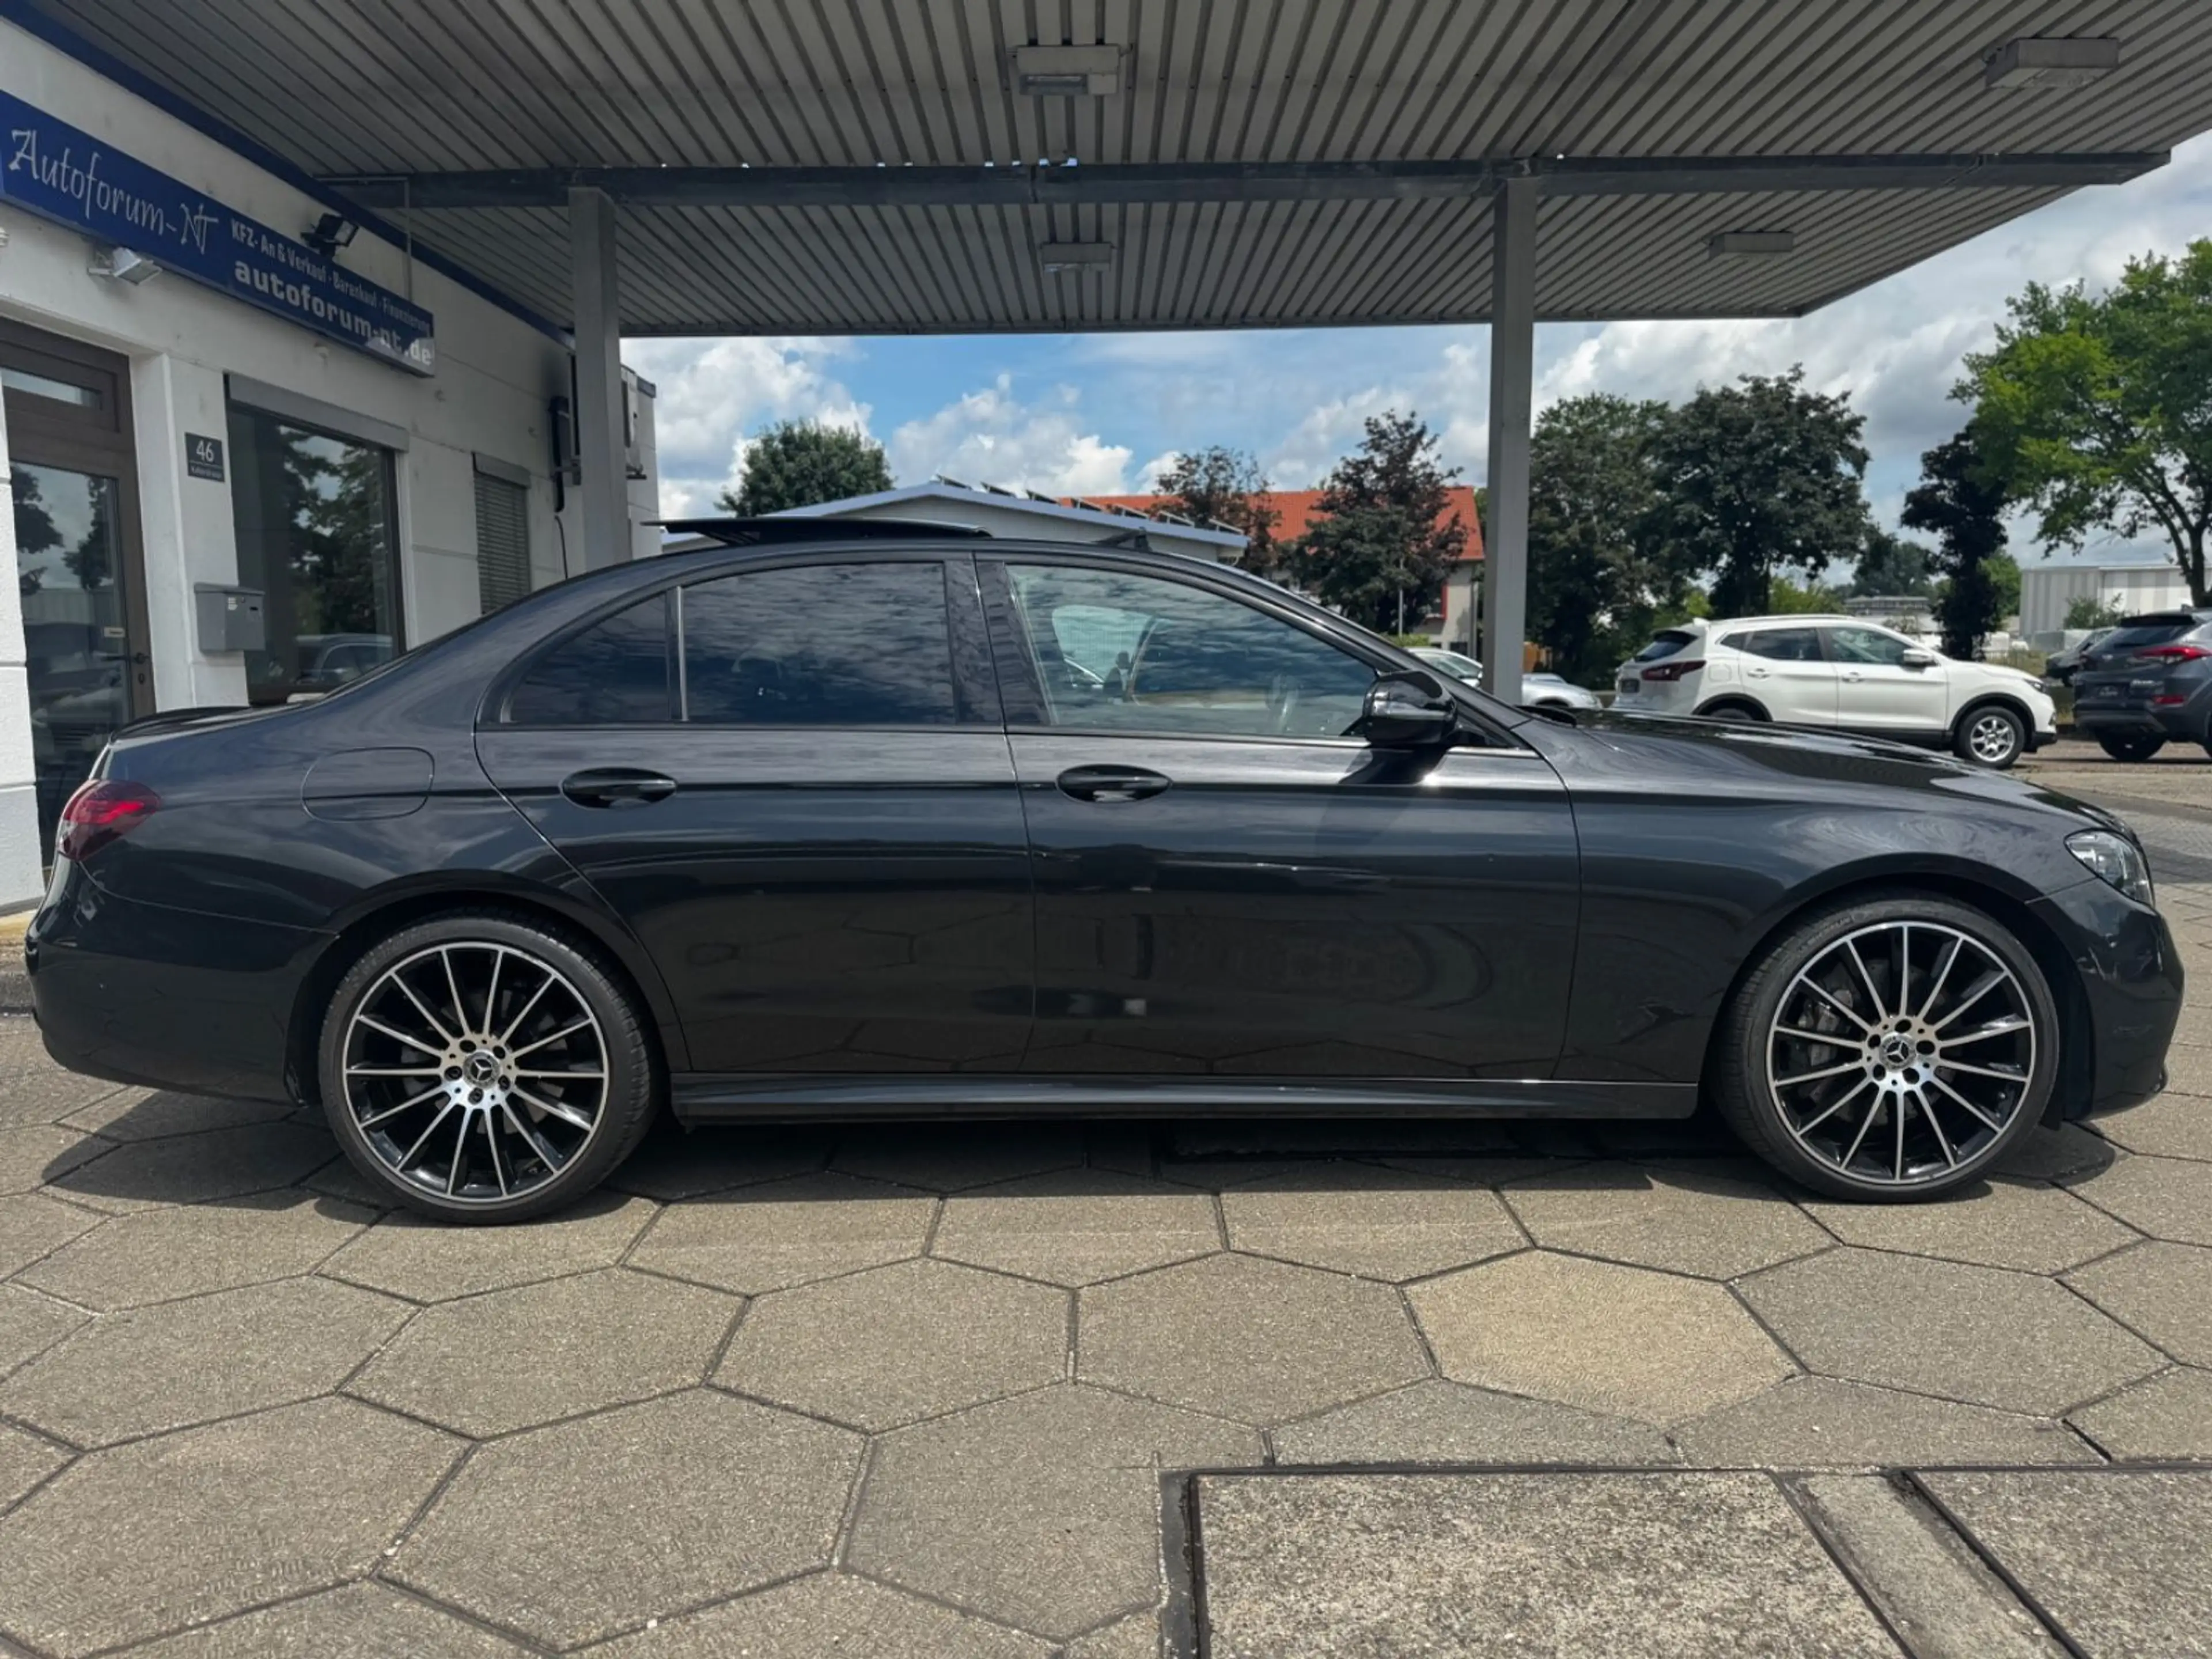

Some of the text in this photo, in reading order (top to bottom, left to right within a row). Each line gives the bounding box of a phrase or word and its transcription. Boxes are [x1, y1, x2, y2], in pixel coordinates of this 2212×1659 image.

[261, 234, 275, 259] An
[278, 243, 286, 263] &
[287, 247, 327, 283] Verkauf
[234, 260, 431, 366] autoforum-nt.de
[196, 440, 215, 463] 46
